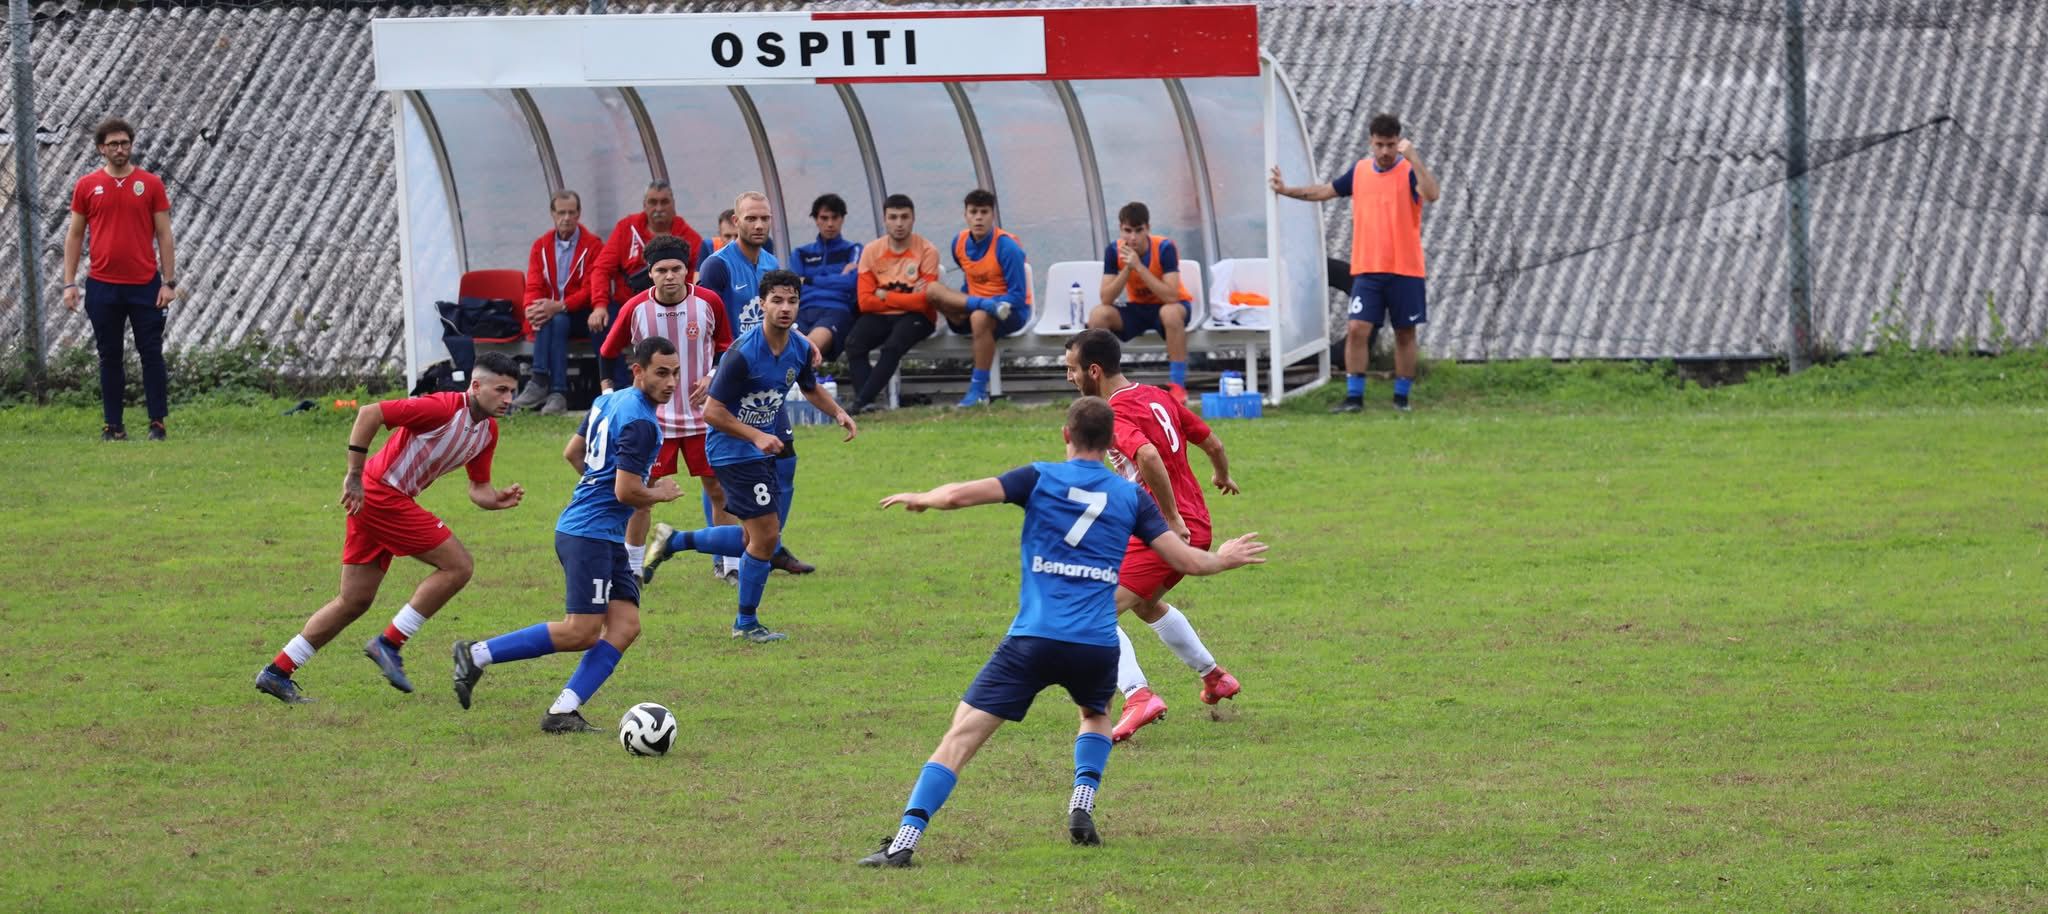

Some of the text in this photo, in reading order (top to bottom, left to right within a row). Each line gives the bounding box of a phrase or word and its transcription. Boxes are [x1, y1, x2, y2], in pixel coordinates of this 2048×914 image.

[711, 30, 917, 68] OSPITI
[1149, 402, 1180, 453] 8
[753, 482, 771, 506] 8
[1063, 486, 1108, 548] 7
